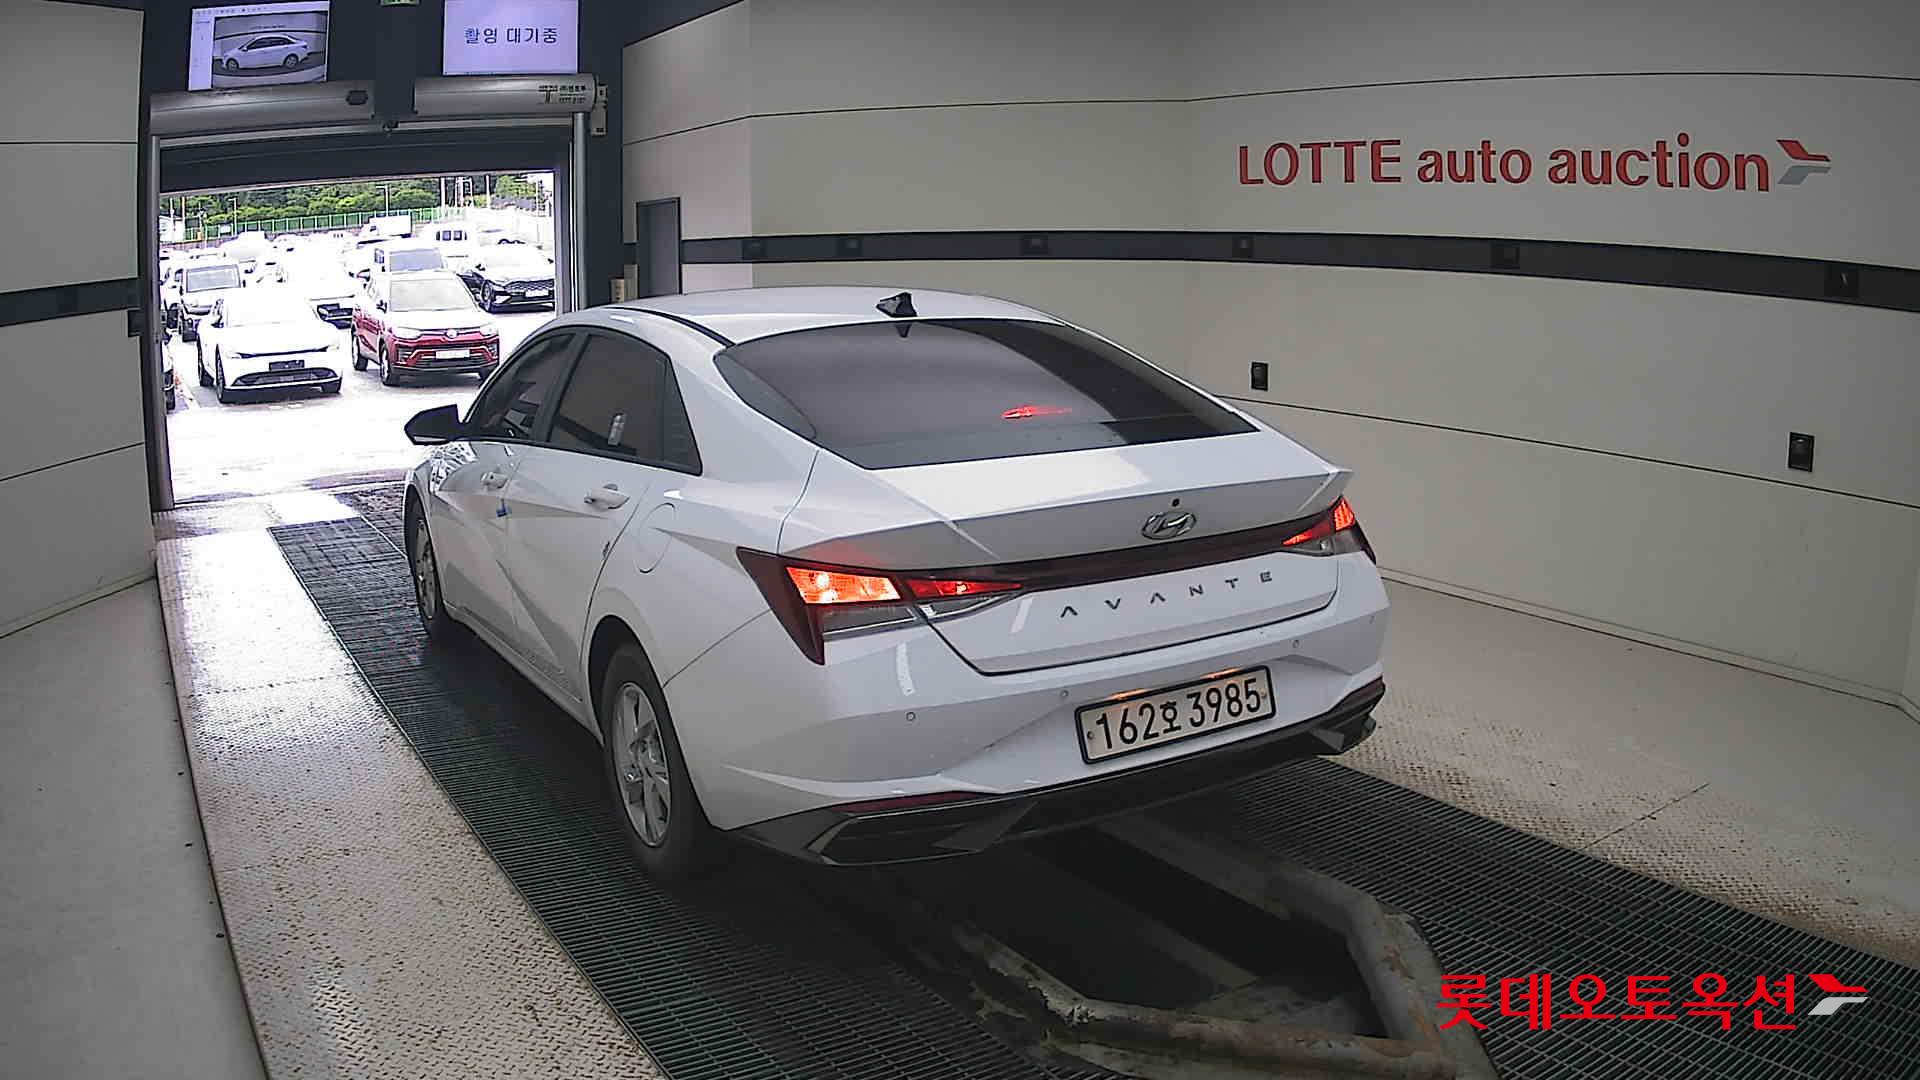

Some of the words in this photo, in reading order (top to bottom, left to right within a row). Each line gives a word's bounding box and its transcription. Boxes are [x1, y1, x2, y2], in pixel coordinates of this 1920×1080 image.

[506, 27, 558, 45] 대기중
[1238, 139, 1402, 187] LOTTE
[1417, 140, 1532, 185] auto
[1548, 132, 1770, 192] auction
[1060, 571, 1273, 618] AVANTE
